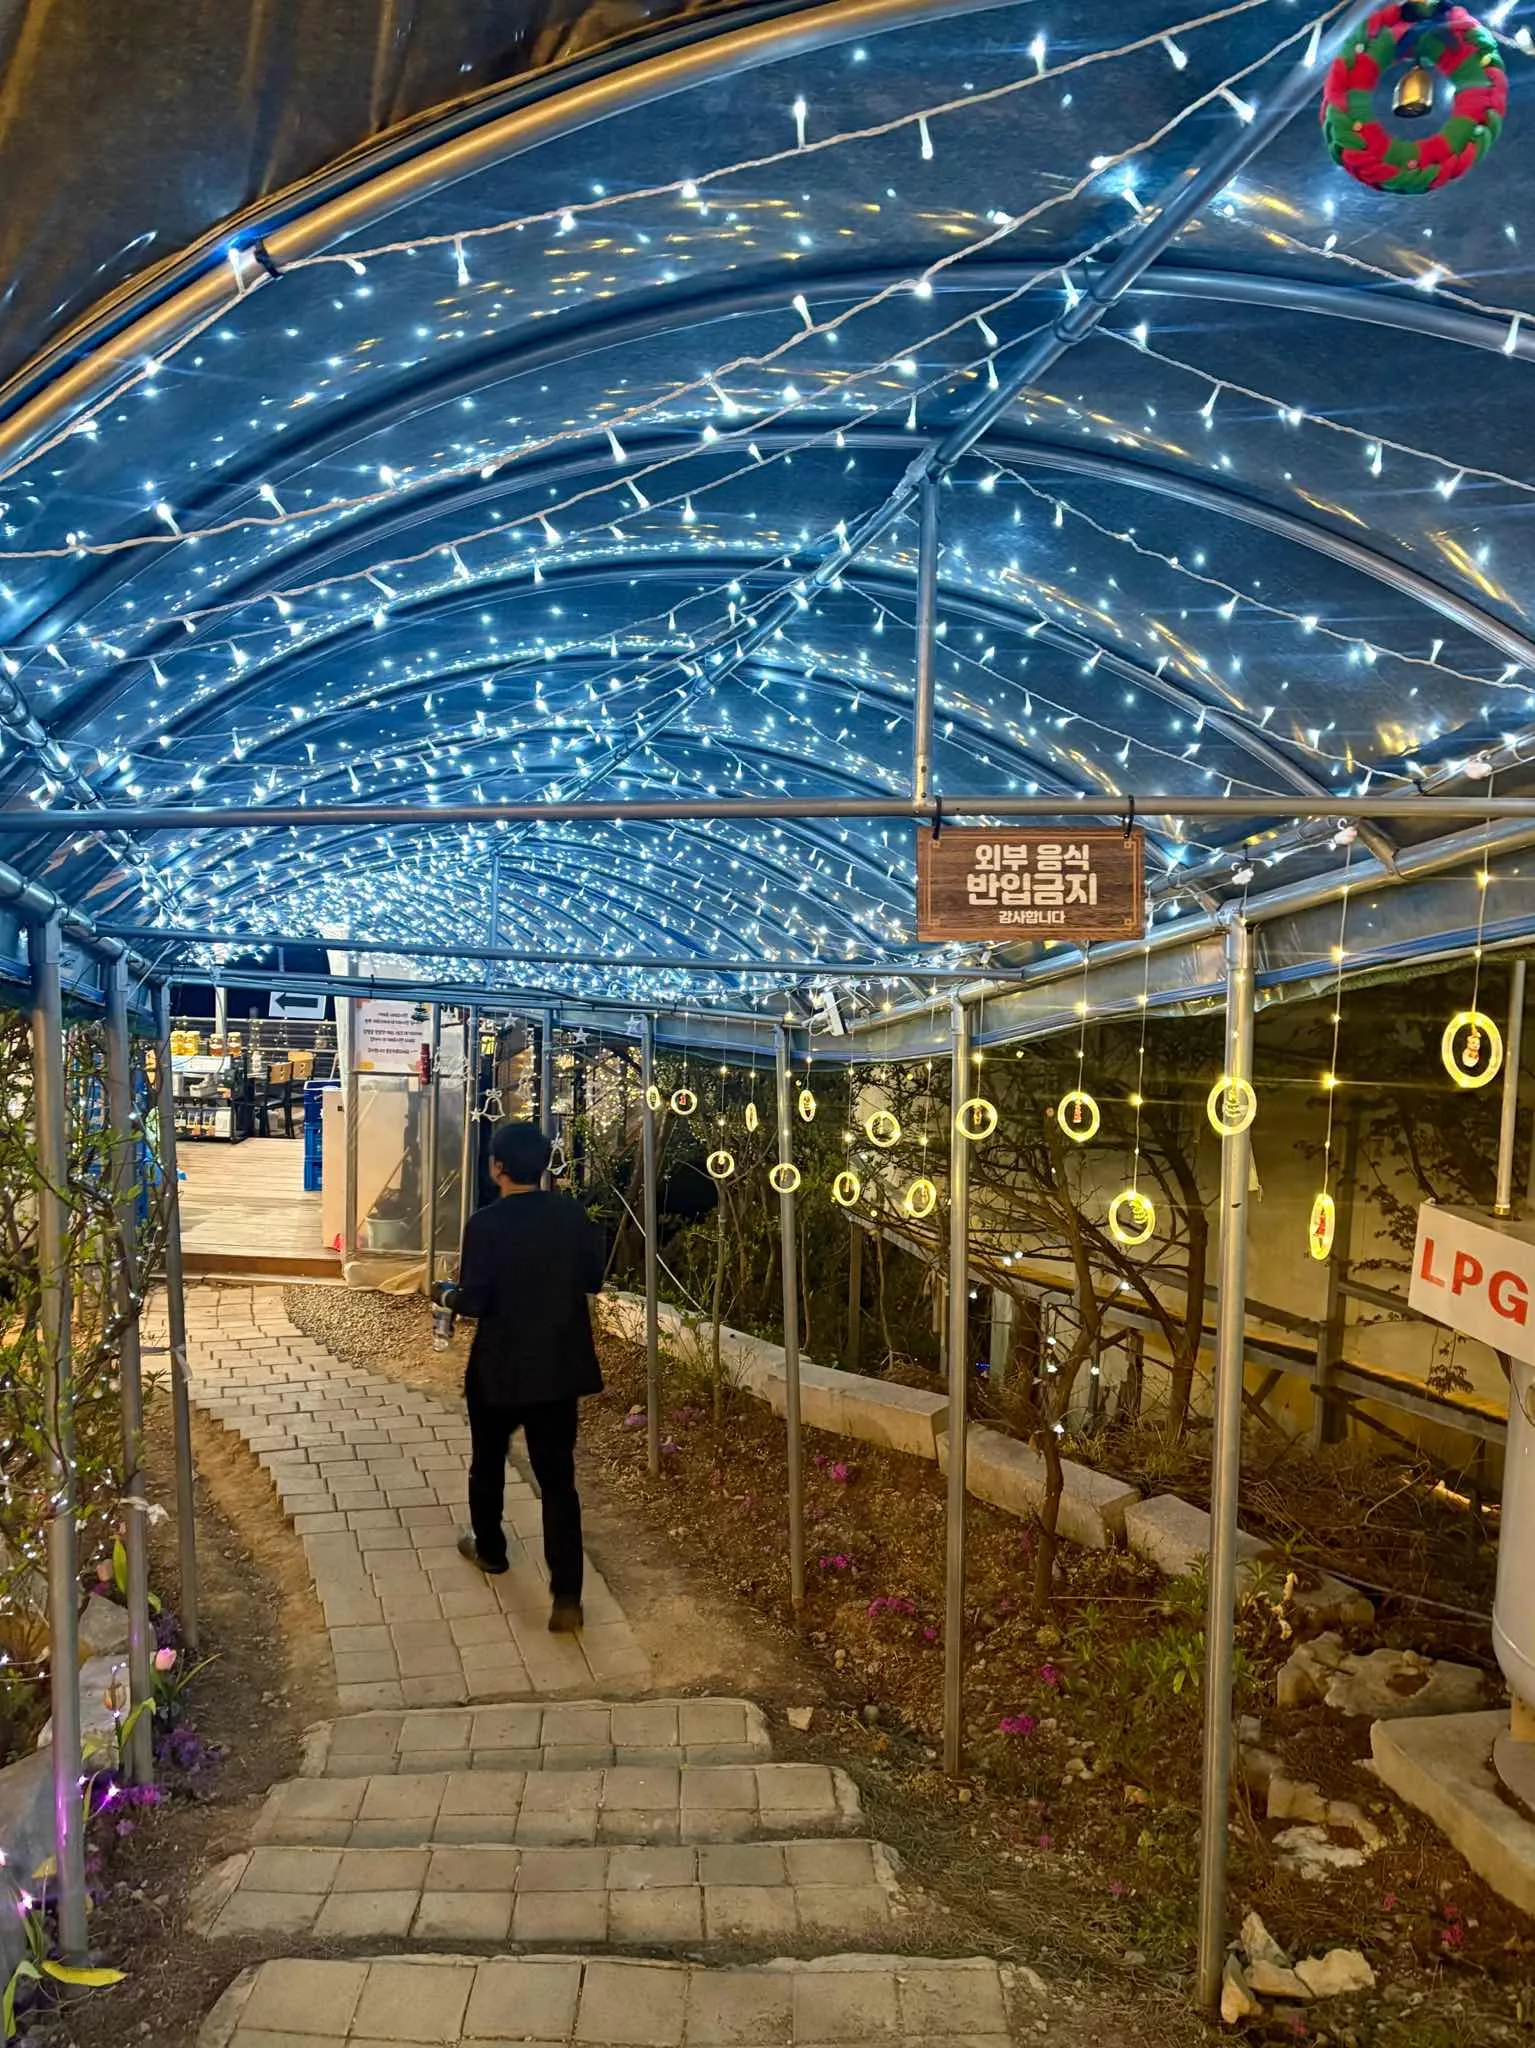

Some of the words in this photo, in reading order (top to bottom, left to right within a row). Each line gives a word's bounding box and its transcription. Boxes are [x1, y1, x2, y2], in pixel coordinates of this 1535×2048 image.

[975, 844, 1028, 871] 외부
[1035, 844, 1090, 871] 음식
[966, 872, 1098, 905] 반입금지
[999, 911, 1065, 924] 감사합니다
[1420, 1237, 1529, 1326] LPG
